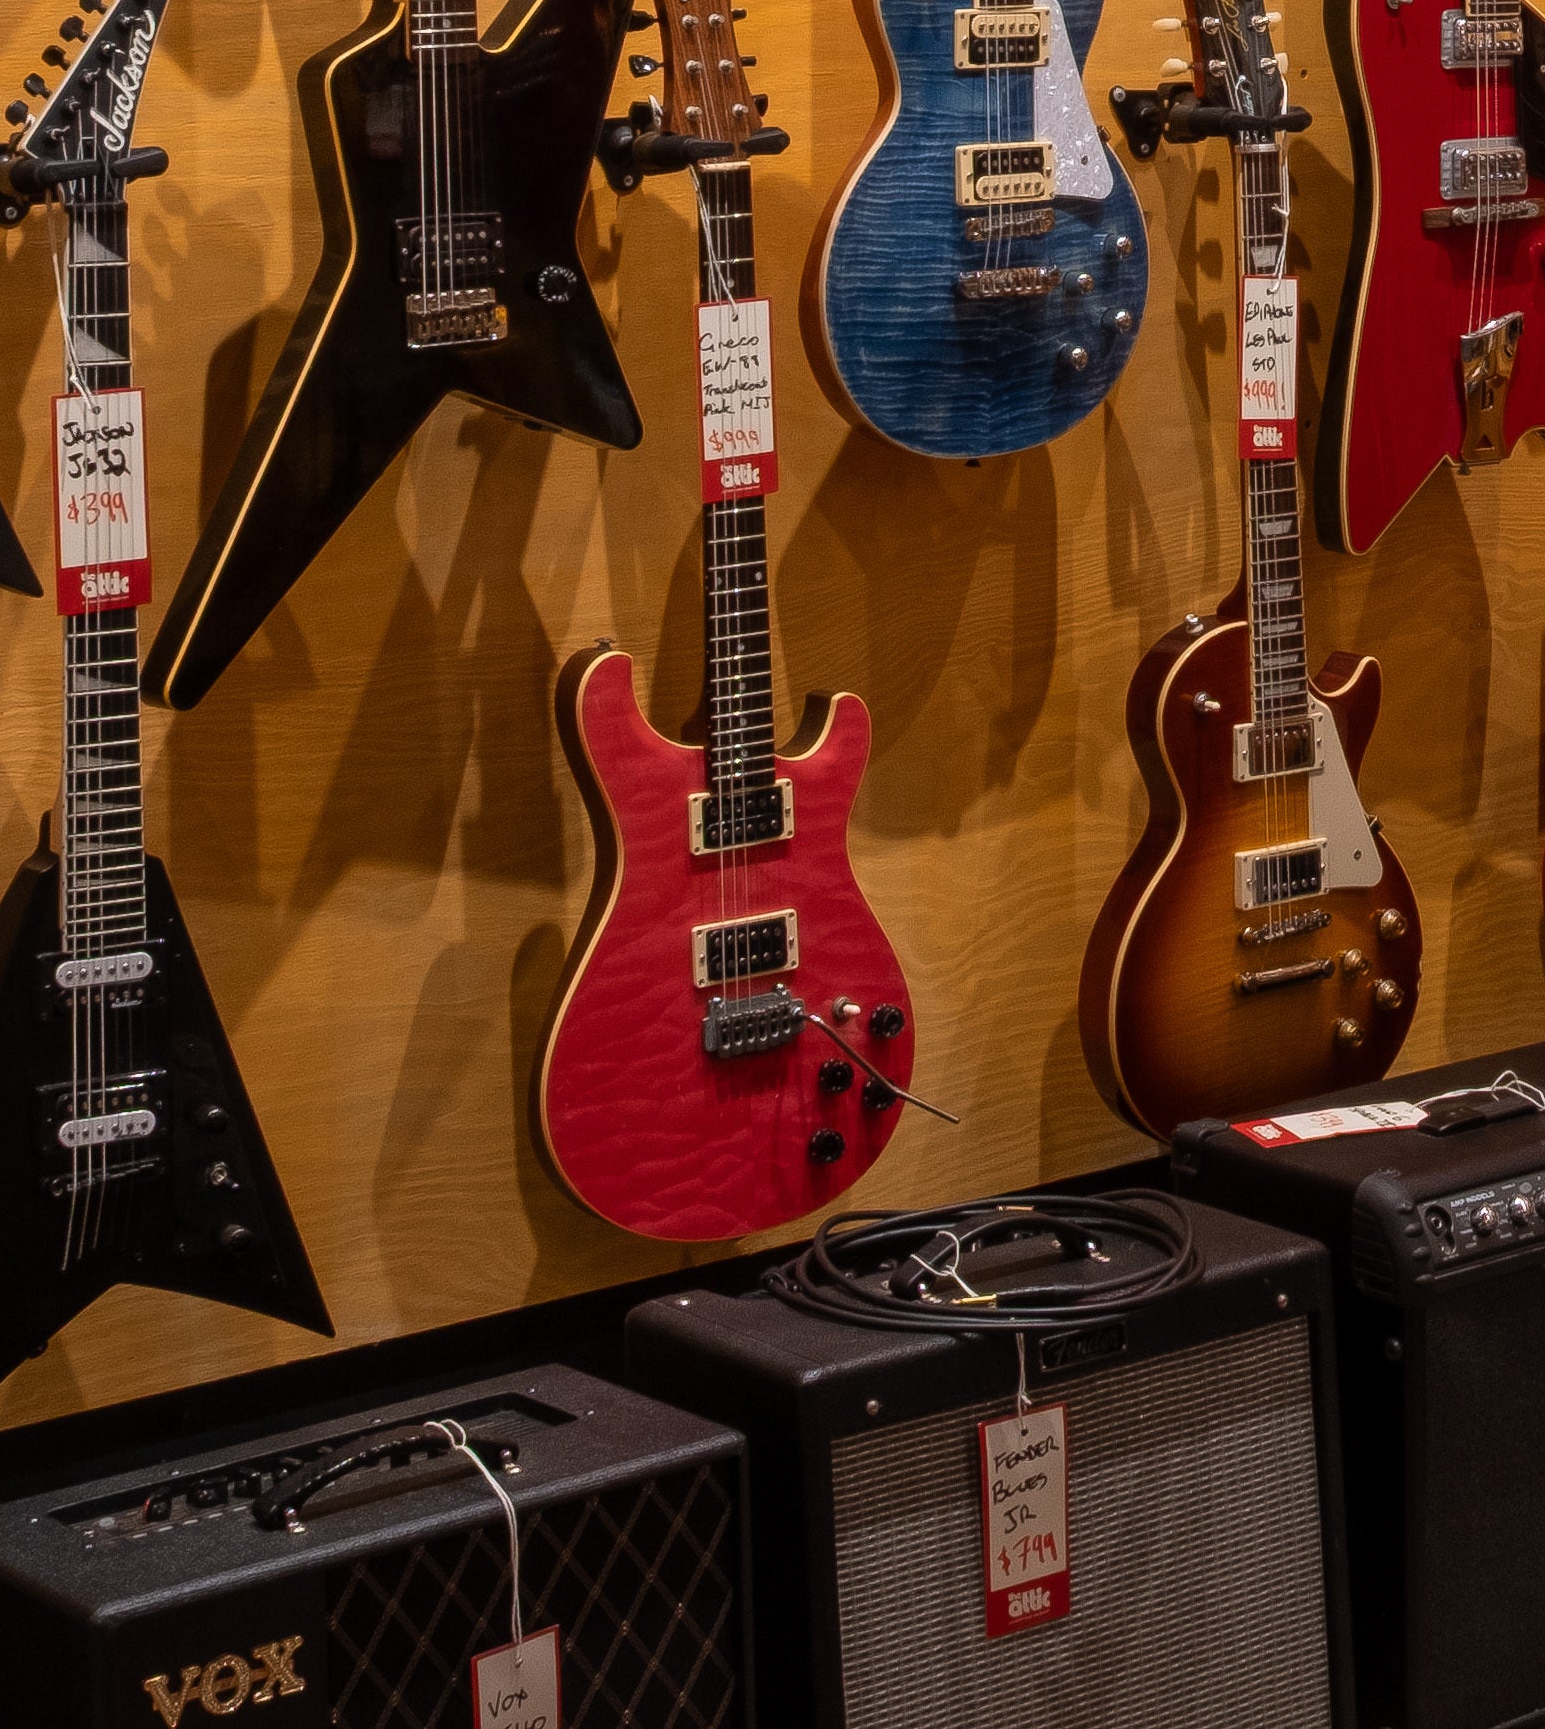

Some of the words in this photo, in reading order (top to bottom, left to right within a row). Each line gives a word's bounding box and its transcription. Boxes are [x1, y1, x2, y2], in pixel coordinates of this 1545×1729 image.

[90, 9, 156, 152] Jackson
[699, 333, 760, 353] Greco
[708, 430, 761, 453] $999
[1253, 424, 1285, 448] attic
[720, 463, 762, 489] attic
[66, 492, 128, 527] $399
[80, 572, 131, 598] attic
[993, 1435, 1060, 1475] FENDER
[993, 1473, 1050, 1506] BLUES
[1002, 1503, 1038, 1535] JR
[998, 1530, 1057, 1577] $799
[1008, 1586, 1052, 1618] attic
[143, 1635, 305, 1729] VOX
[487, 1689, 529, 1720] Vox
